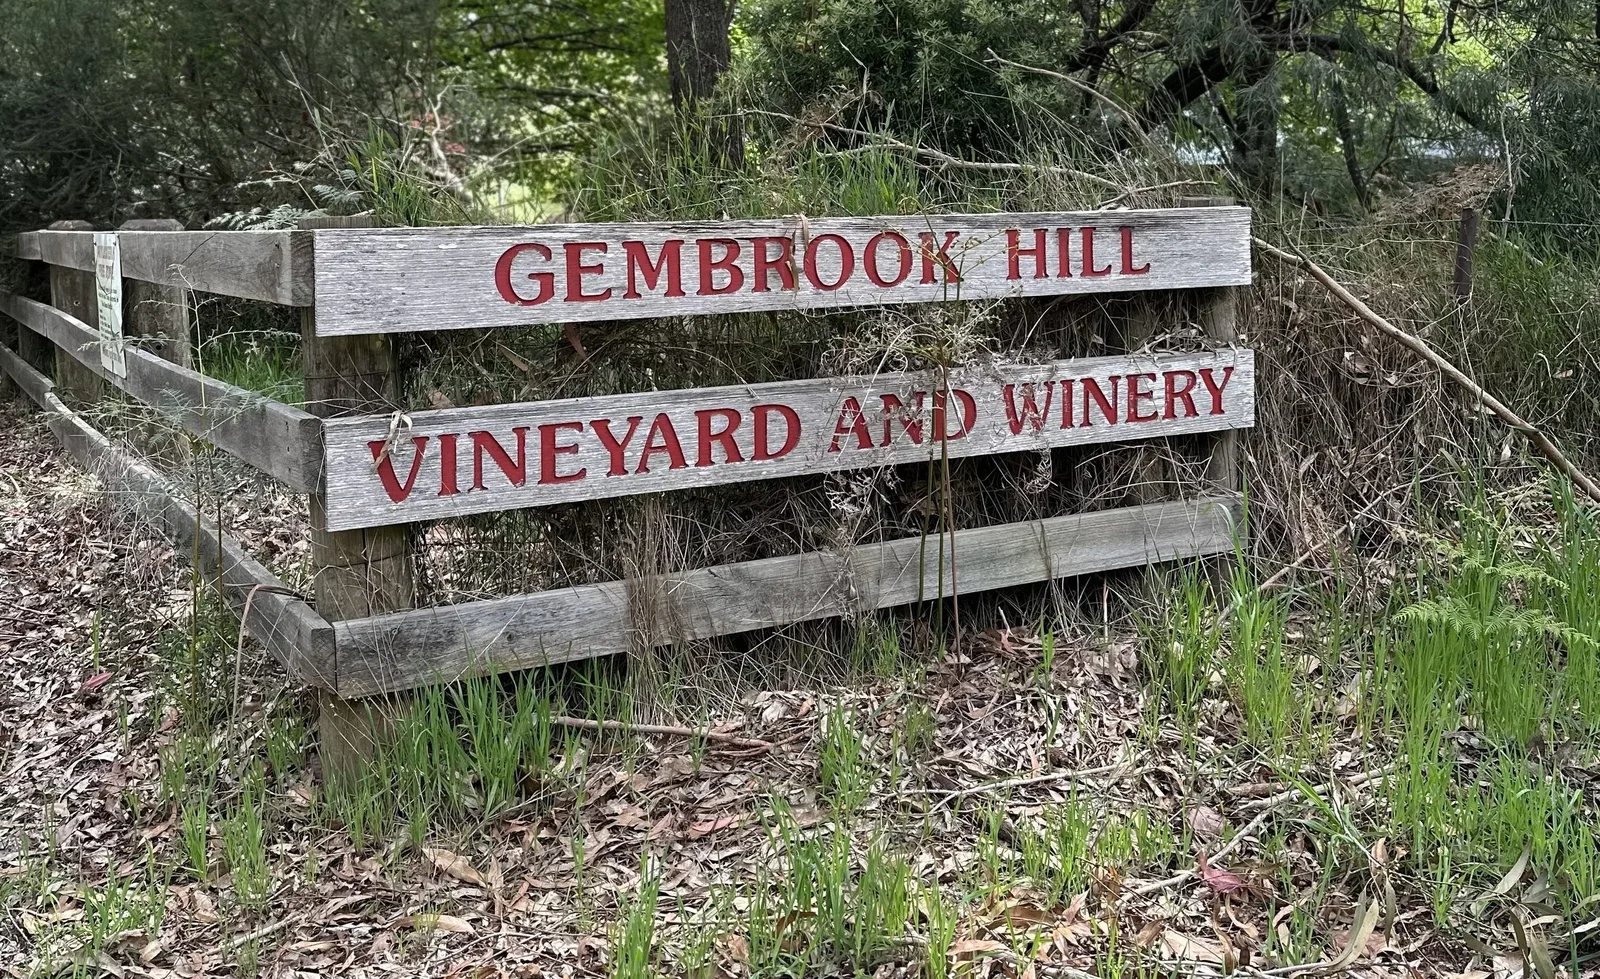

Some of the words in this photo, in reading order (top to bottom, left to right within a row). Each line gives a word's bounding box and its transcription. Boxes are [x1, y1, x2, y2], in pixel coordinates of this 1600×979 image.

[494, 232, 963, 307] GEMBROOK
[1006, 226, 1151, 280] HILL
[367, 403, 801, 504] VINEYARD
[828, 389, 978, 453] AND
[1003, 366, 1235, 436] WINERY
